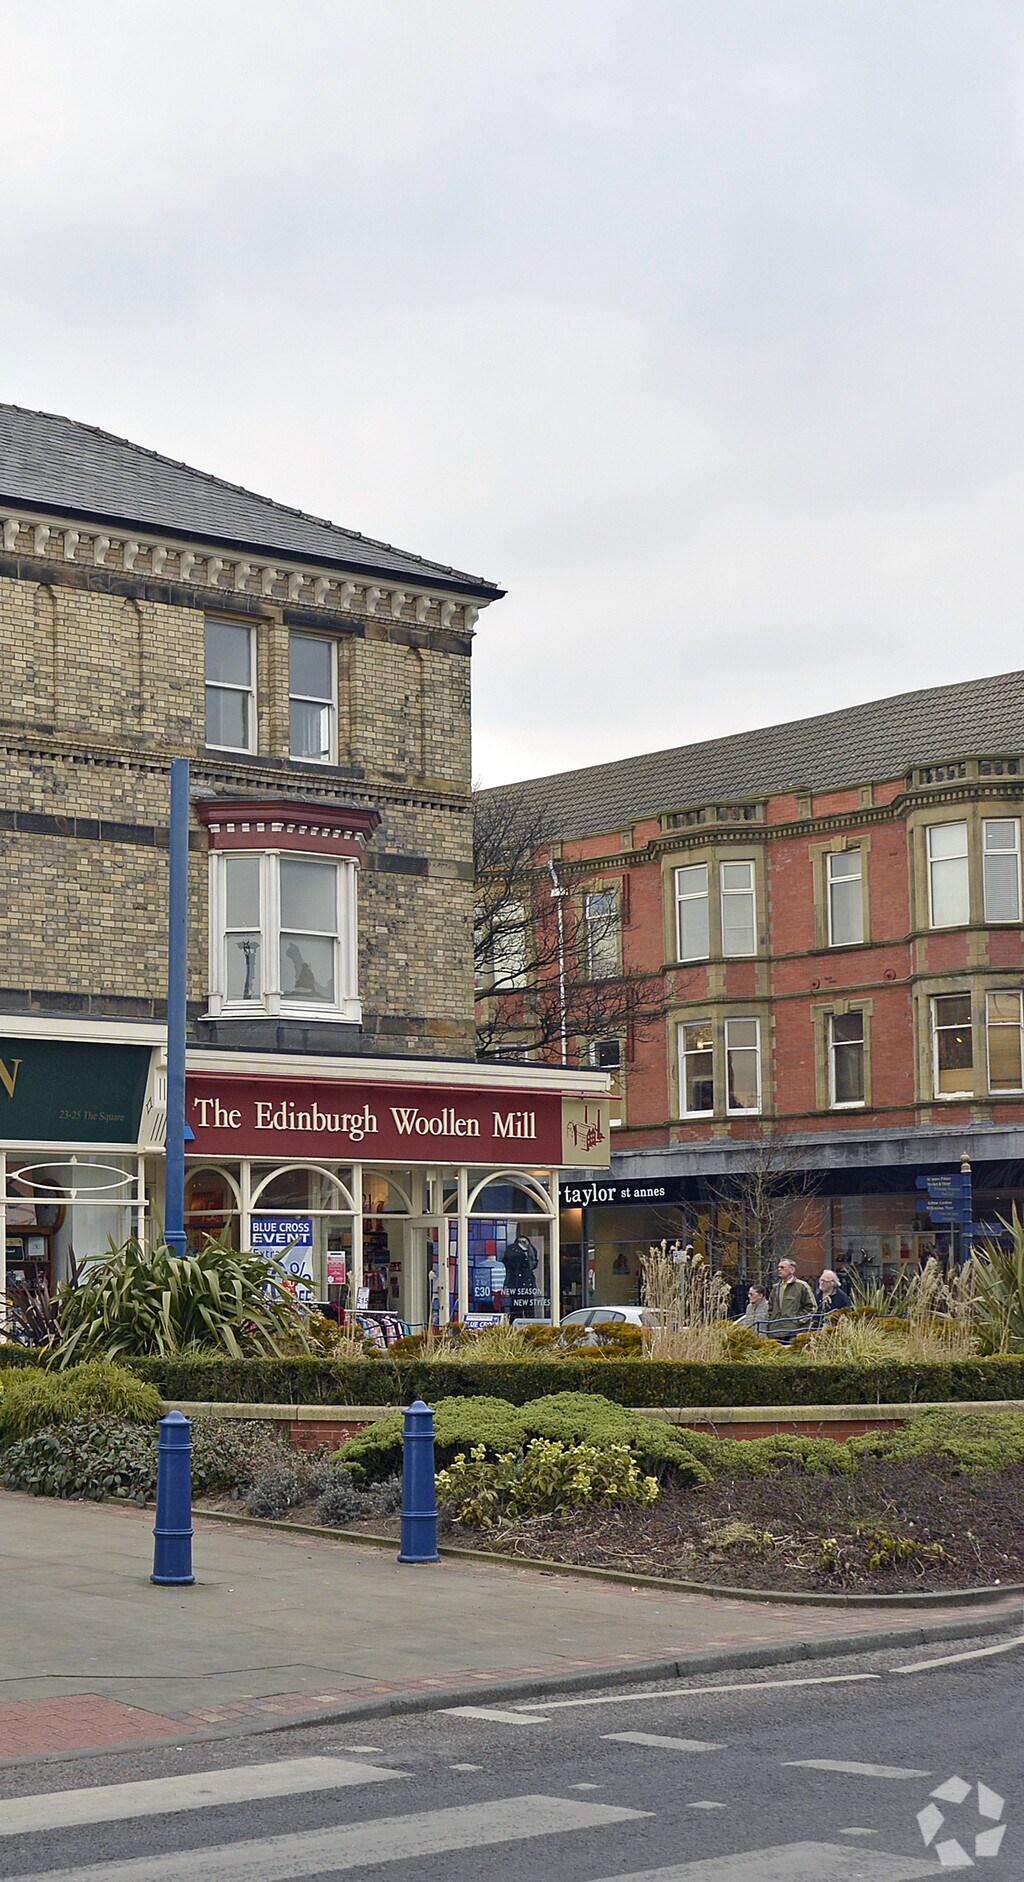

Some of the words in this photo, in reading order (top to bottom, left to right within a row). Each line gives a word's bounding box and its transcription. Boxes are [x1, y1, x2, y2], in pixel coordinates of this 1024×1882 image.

[83, 1111, 97, 1120] The
[99, 1111, 125, 1123] Square
[193, 1098, 242, 1129] The
[254, 1101, 379, 1142] Edinburgh
[389, 1107, 481, 1137] Woollen
[491, 1111, 537, 1139] Mill
[564, 1183, 617, 1207] taylor
[620, 1187, 632, 1198] st
[633, 1187, 666, 1198] annes
[252, 1222, 277, 1233] BLUE
[279, 1222, 310, 1233] CROSS
[252, 1233, 311, 1244] EVENT
[474, 1286, 490, 1297] £30
[517, 1288, 542, 1296] SEASON
[513, 1299, 529, 1307] NEW
[529, 1299, 551, 1307] STYLES
